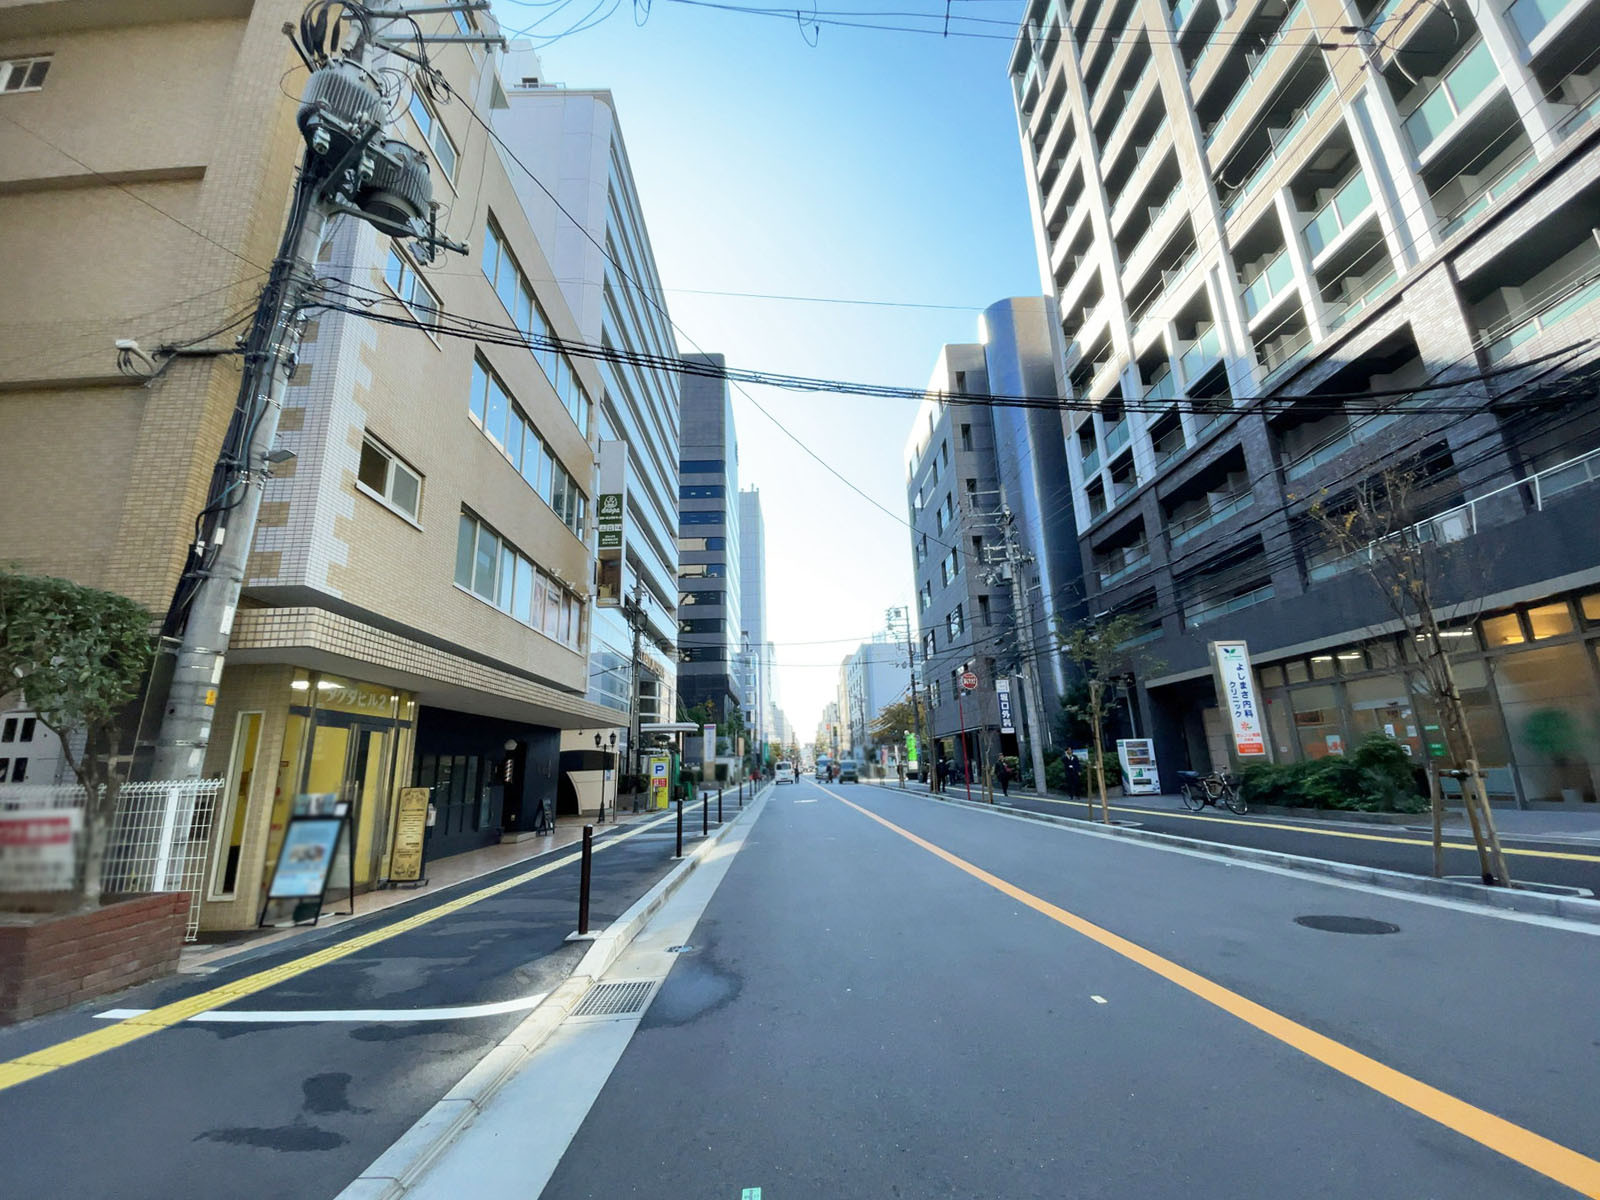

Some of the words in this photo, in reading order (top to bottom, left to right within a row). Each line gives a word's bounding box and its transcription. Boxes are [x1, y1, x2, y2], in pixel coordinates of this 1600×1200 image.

[1229, 681, 1242, 718] クリニック
[1236, 663, 1253, 718] よしまさ内科
[655, 765, 665, 774] P
